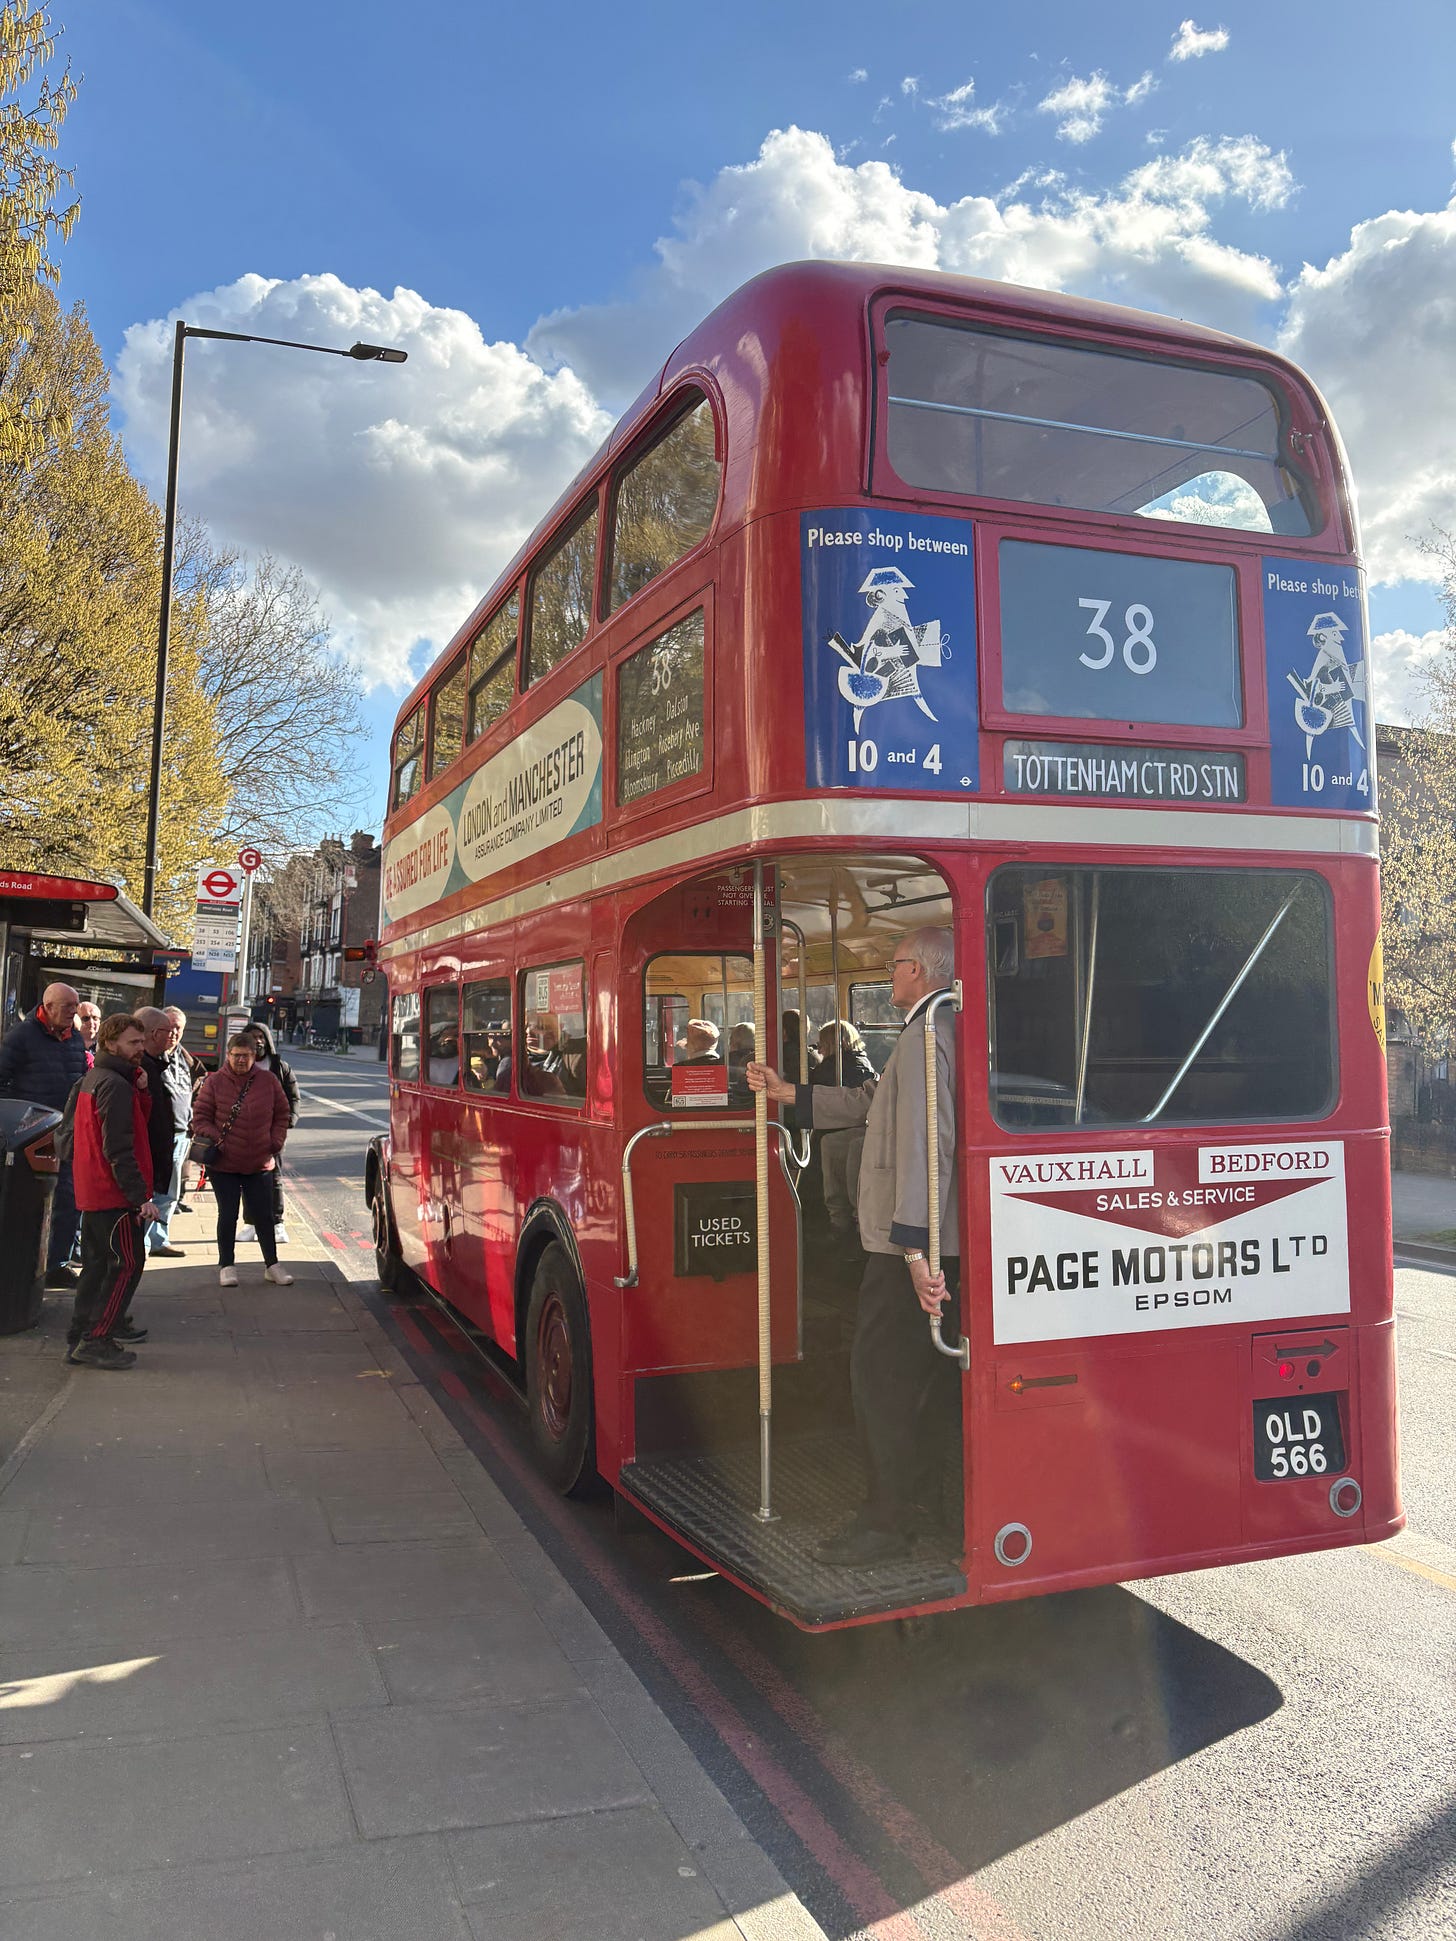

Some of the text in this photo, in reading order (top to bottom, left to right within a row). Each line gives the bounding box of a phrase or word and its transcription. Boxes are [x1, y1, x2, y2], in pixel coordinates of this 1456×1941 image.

[808, 527, 968, 555] Please shop between
[1268, 573, 1307, 592] Please
[1312, 578, 1338, 600] shop
[1078, 597, 1157, 675] 38
[651, 649, 671, 695] 38
[631, 695, 689, 739] Hackney Dalston
[658, 727, 683, 755] Rosebery
[685, 718, 700, 741] Ave
[848, 740, 942, 775] 10 and 4
[463, 730, 584, 847] LONDON and MANCHESTER
[624, 771, 658, 798] Bloomsbury
[1013, 755, 1238, 797] TOTTENHAM CT RD STN
[1302, 763, 1369, 796] 10 and 4
[475, 797, 562, 861] ASSURANCE COMPANY LIMITED
[242, 851, 256, 867] G
[393, 849, 418, 896] ASSURED
[420, 839, 431, 880] FOR
[433, 827, 449, 873] LIFE
[12, 882, 32, 890] Road
[1000, 1151, 1330, 1184] VAUXHALL BEDFORD
[1096, 1186, 1256, 1212] SALES & SERVICE
[692, 1230, 751, 1248] TICKETS
[699, 1217, 742, 1232] USED
[1007, 1235, 1328, 1295] PAGE MOTORS LTD
[1135, 1288, 1232, 1311] EPSOM
[1266, 1409, 1322, 1445] OLD
[1271, 1443, 1328, 1478] 566
